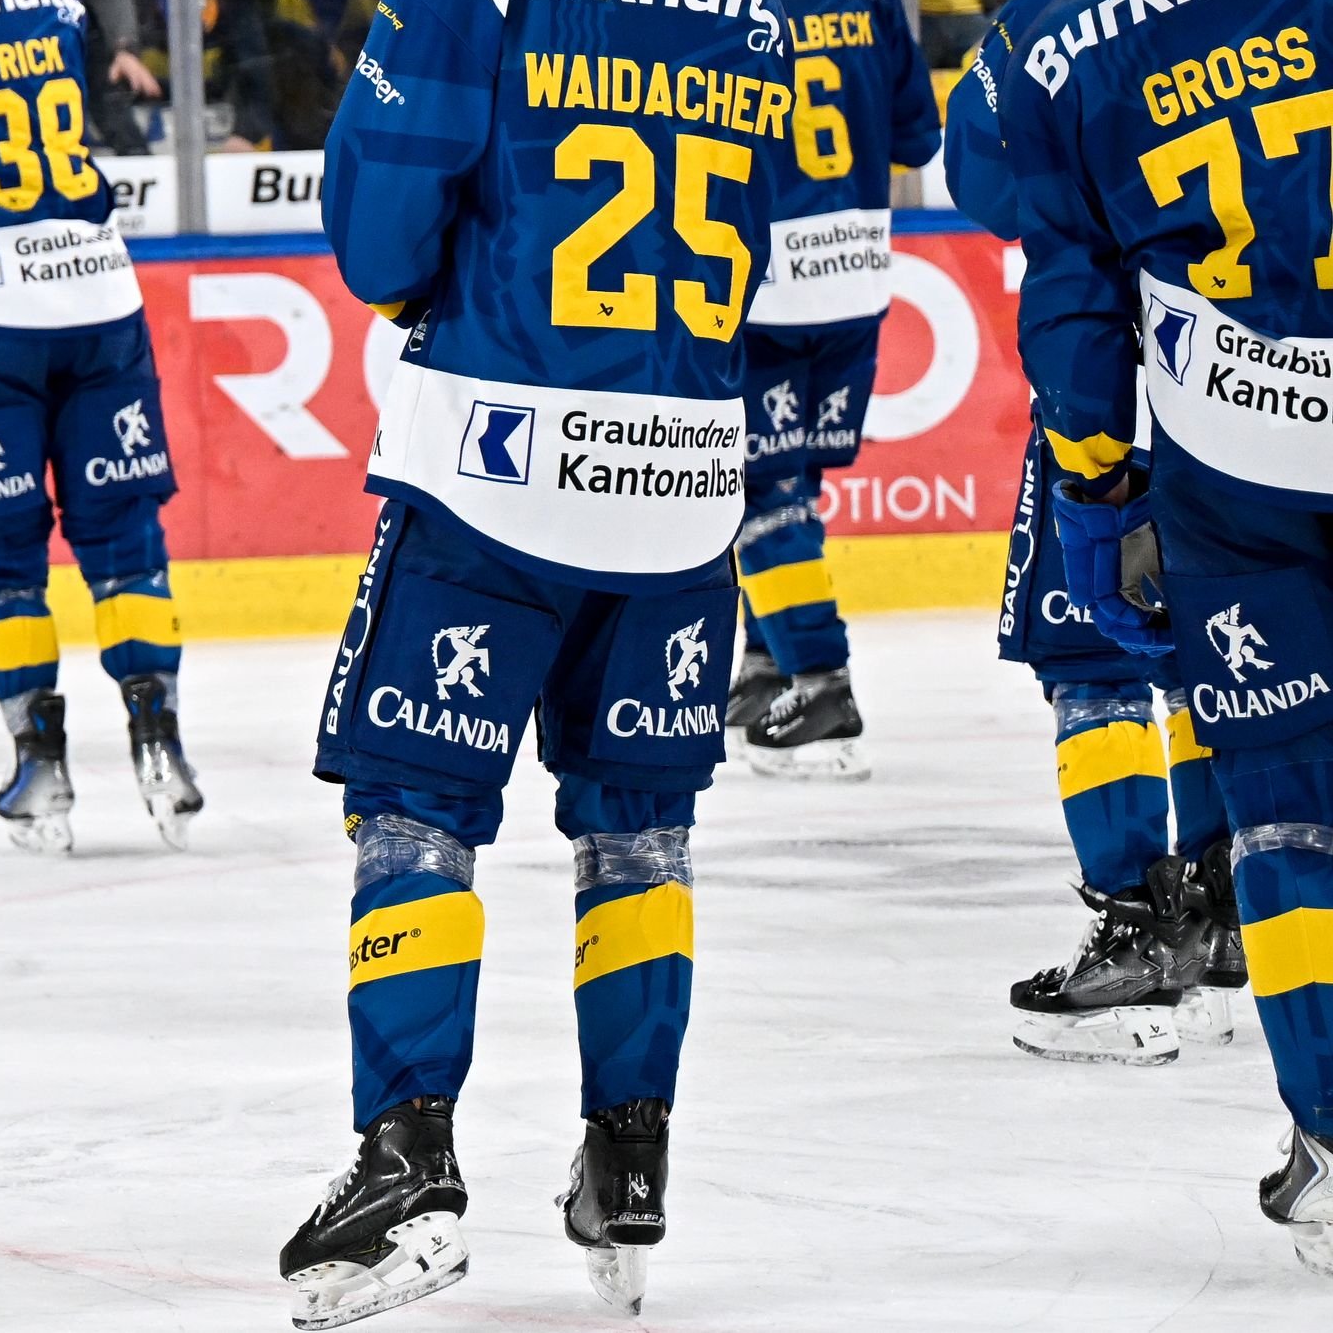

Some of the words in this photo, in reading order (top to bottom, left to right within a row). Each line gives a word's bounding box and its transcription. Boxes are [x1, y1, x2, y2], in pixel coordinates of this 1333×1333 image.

[789, 11, 874, 53] LBECK
[525, 52, 793, 142] WAIDACHER
[1142, 26, 1317, 127] GROSS
[794, 55, 854, 181] 6
[1138, 90, 1333, 301] 77
[550, 123, 753, 343] 25
[1206, 363, 1333, 425] Kanto
[561, 410, 741, 450] Graubündner
[558, 453, 746, 501] Kantonalba
[817, 472, 978, 525] OTION
[999, 564, 1022, 638] BAU
[325, 646, 354, 736] BAU
[367, 685, 510, 755] CALANDA
[606, 696, 721, 740] CALANDA
[1193, 671, 1331, 724] CALANDA
[617, 1212, 661, 1223] BAUER
